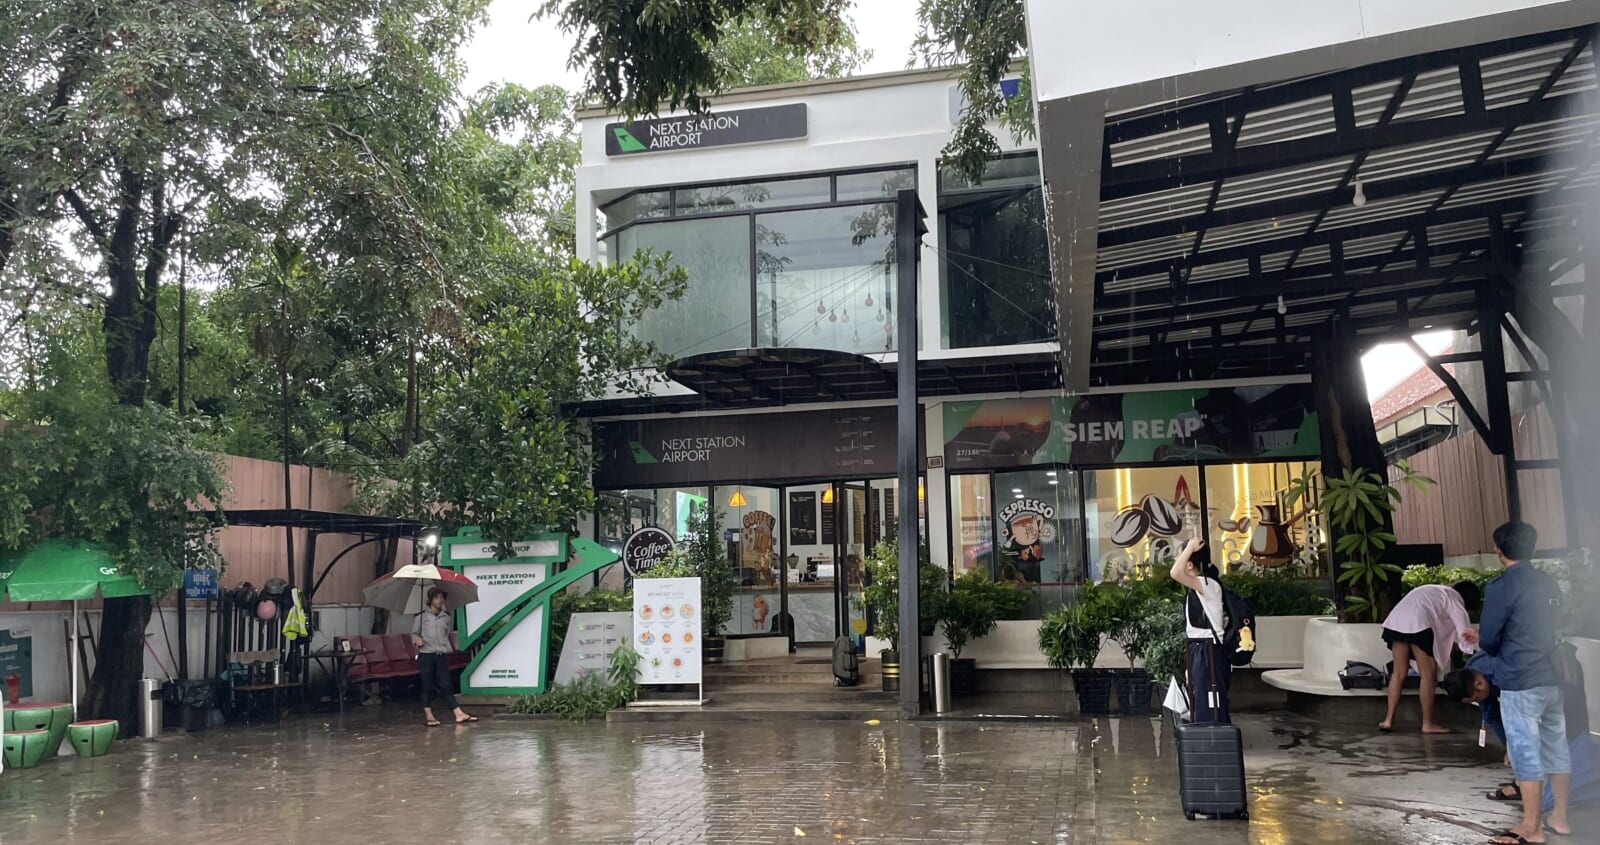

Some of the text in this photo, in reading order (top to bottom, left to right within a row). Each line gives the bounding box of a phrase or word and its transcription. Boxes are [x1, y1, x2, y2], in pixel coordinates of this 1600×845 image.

[650, 122, 682, 137] NEXT
[649, 132, 702, 149] AIRPORT
[662, 435, 745, 451] NEXT STATION
[662, 449, 712, 463] AIRPORT
[999, 499, 1054, 522] ESPRESSO
[513, 545, 531, 553] HOP
[633, 541, 668, 559] Coffee
[634, 556, 661, 570] Time
